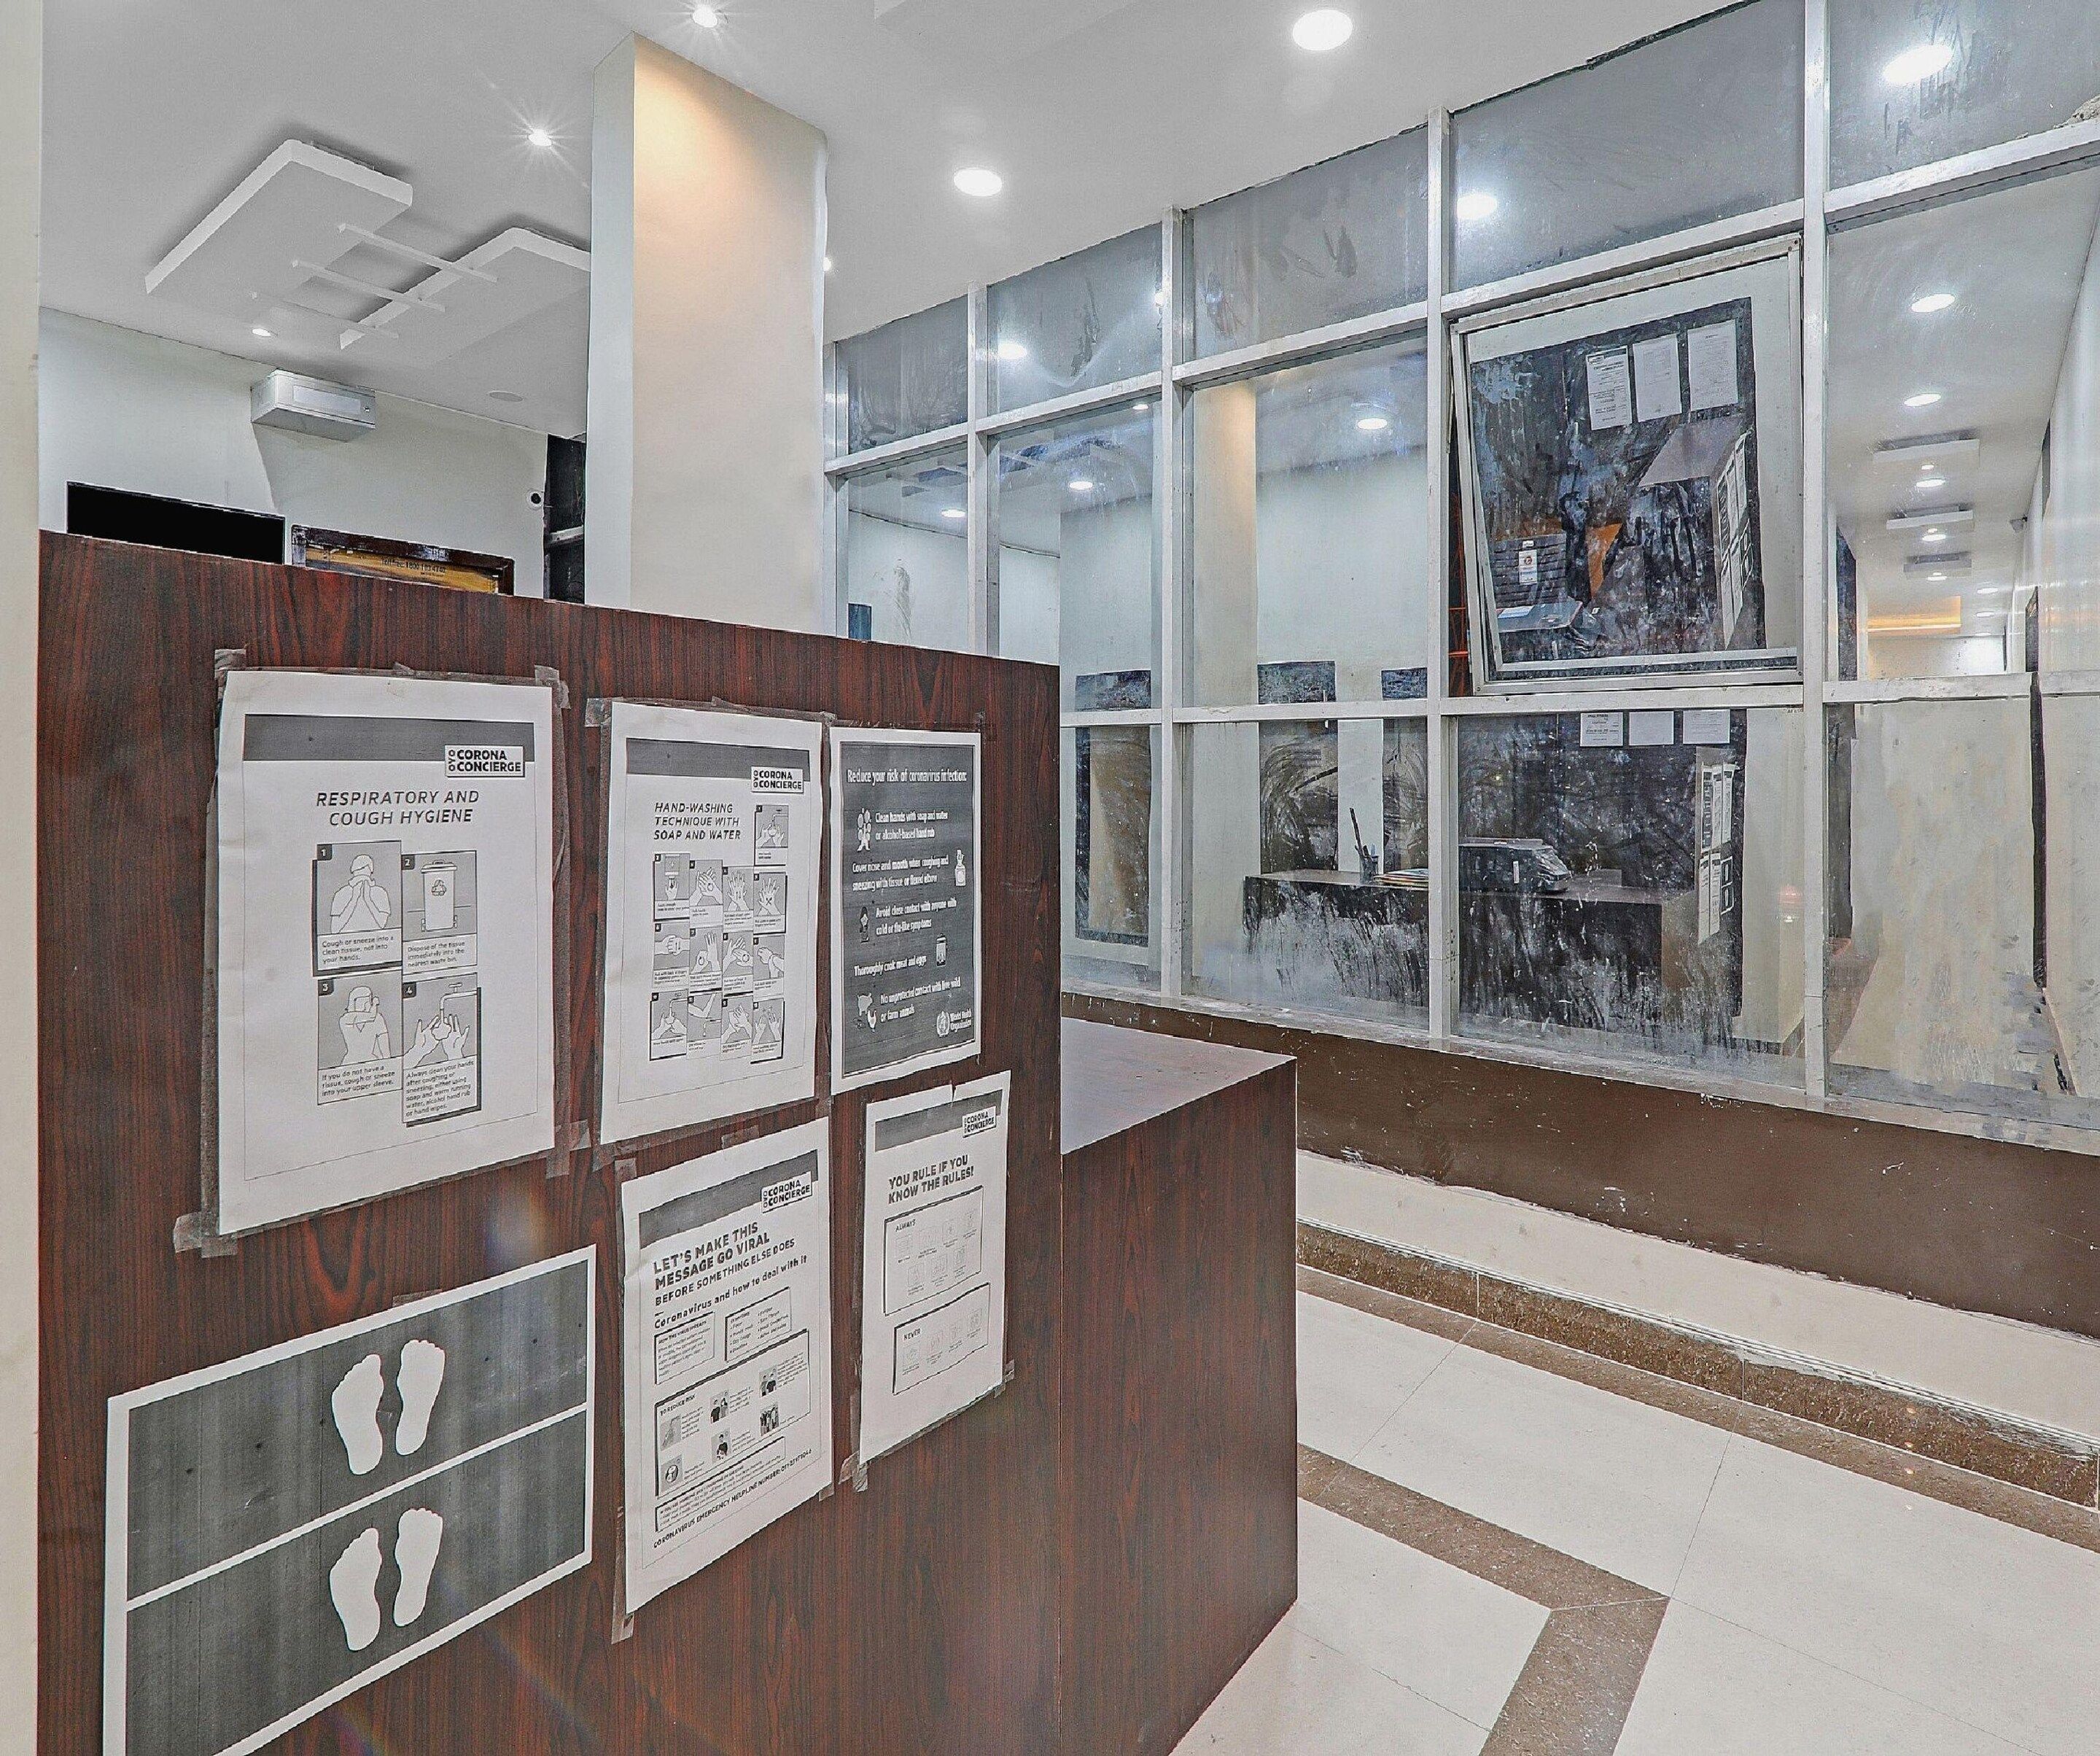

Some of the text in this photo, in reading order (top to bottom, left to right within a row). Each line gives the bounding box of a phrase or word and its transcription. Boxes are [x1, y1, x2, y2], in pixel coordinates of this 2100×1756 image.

[457, 750, 507, 760] CORONA
[457, 761, 521, 772] CONCIERGE
[759, 770, 793, 780] CORONA
[847, 769, 871, 783] Reduce
[872, 769, 885, 786] your
[887, 769, 898, 782] risk
[901, 769, 908, 782] of
[909, 769, 940, 782] coronavirus
[759, 780, 801, 790] CONCIERGE
[316, 790, 479, 807] RESPIRATORY AND
[655, 803, 733, 813] HAND-WASHING
[330, 809, 473, 825] COUGH HYGIENE
[655, 817, 739, 826] TECHNIQUE WITH
[876, 810, 948, 823] Clean hands with soap and water
[654, 829, 741, 839] SOAP AND WATER
[876, 828, 935, 840] or alcohol-based hand rub
[321, 849, 327, 857] 1
[322, 983, 328, 992] 3
[967, 1111, 988, 1124] CORONA
[967, 1117, 995, 1132] CONCIERGE
[889, 1154, 968, 1189] YOU RULE IF YOU
[769, 1179, 801, 1197] CORONA
[888, 1166, 974, 1204] KNOW THE RULES!
[769, 1184, 810, 1207] CONCIERGE
[895, 1219, 916, 1232] ALWAYS
[695, 1234, 729, 1259] MAKE
[731, 1221, 758, 1240] THIS
[656, 1232, 770, 1291] MESSAGE GO VIRAL
[656, 1238, 795, 1307] BEFORE SOMETHING ELSE DOES
[654, 1255, 807, 1329] Coronavirus and how to deal with it
[903, 1329, 921, 1340] NEVER
[653, 1516, 696, 1548] CORONAVIRUS
[696, 1499, 729, 1523] EMERGENCY
[731, 1482, 758, 1502] HELPLINE
